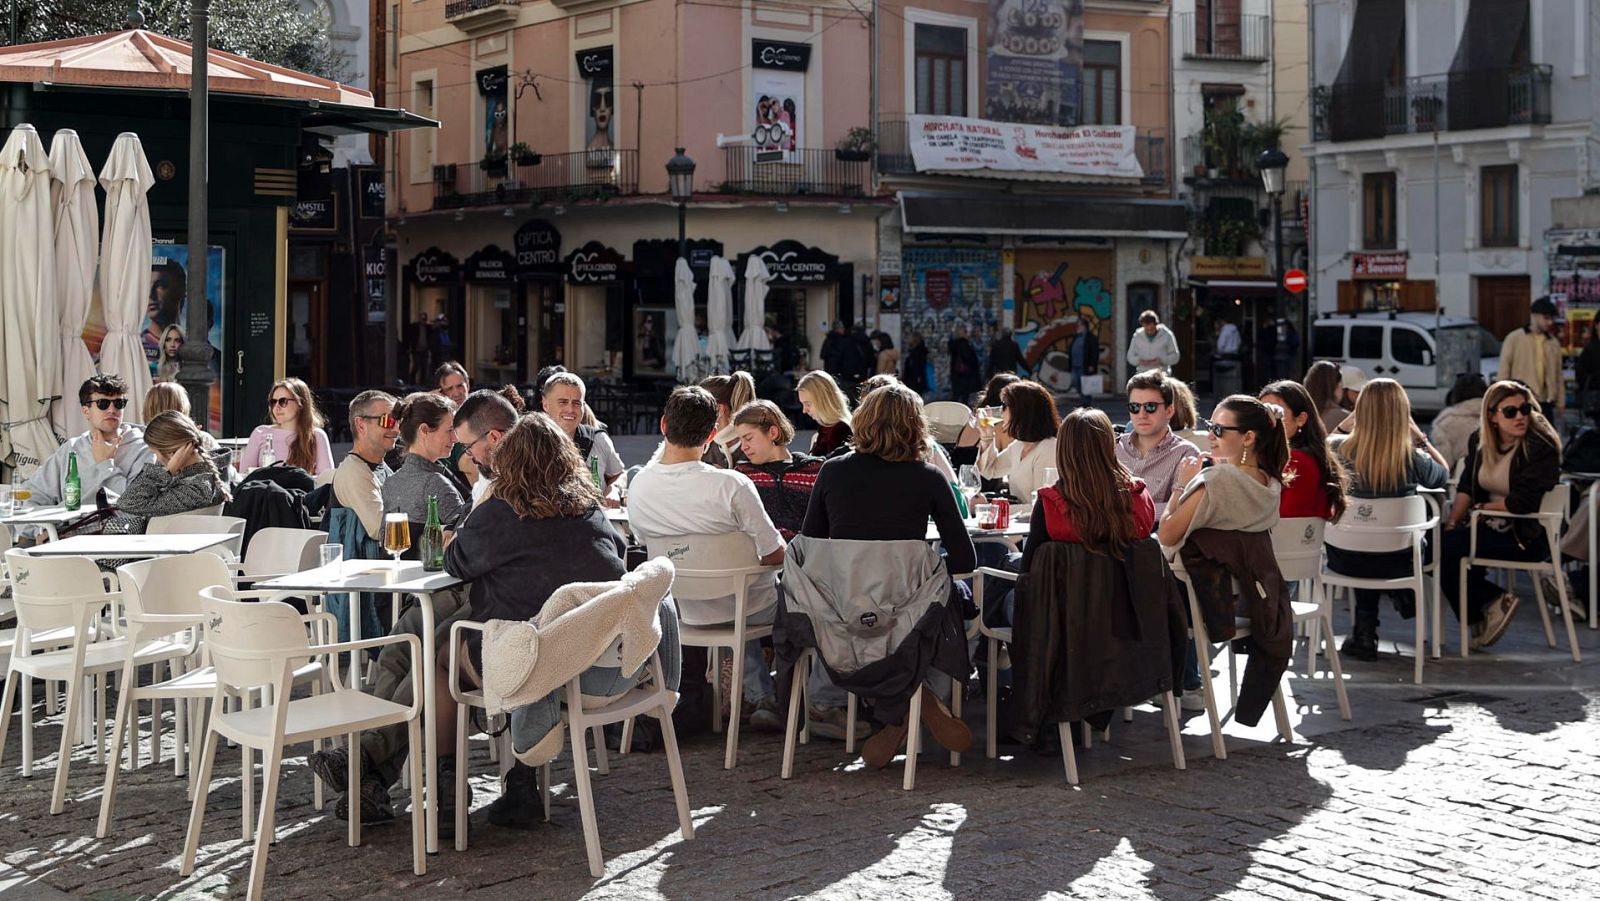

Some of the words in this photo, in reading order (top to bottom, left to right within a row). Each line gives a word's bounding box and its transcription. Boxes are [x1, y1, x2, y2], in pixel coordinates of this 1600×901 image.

[923, 122, 963, 132] HORCHATA
[965, 125, 1003, 136] NATURAL
[296, 202, 326, 212] AMSTEL
[517, 250, 556, 266] CENTRO
[594, 263, 617, 272] CENTRO
[764, 263, 791, 272] PTICA
[791, 263, 826, 272] CENTRO
[1367, 262, 1406, 273] Souvenir
